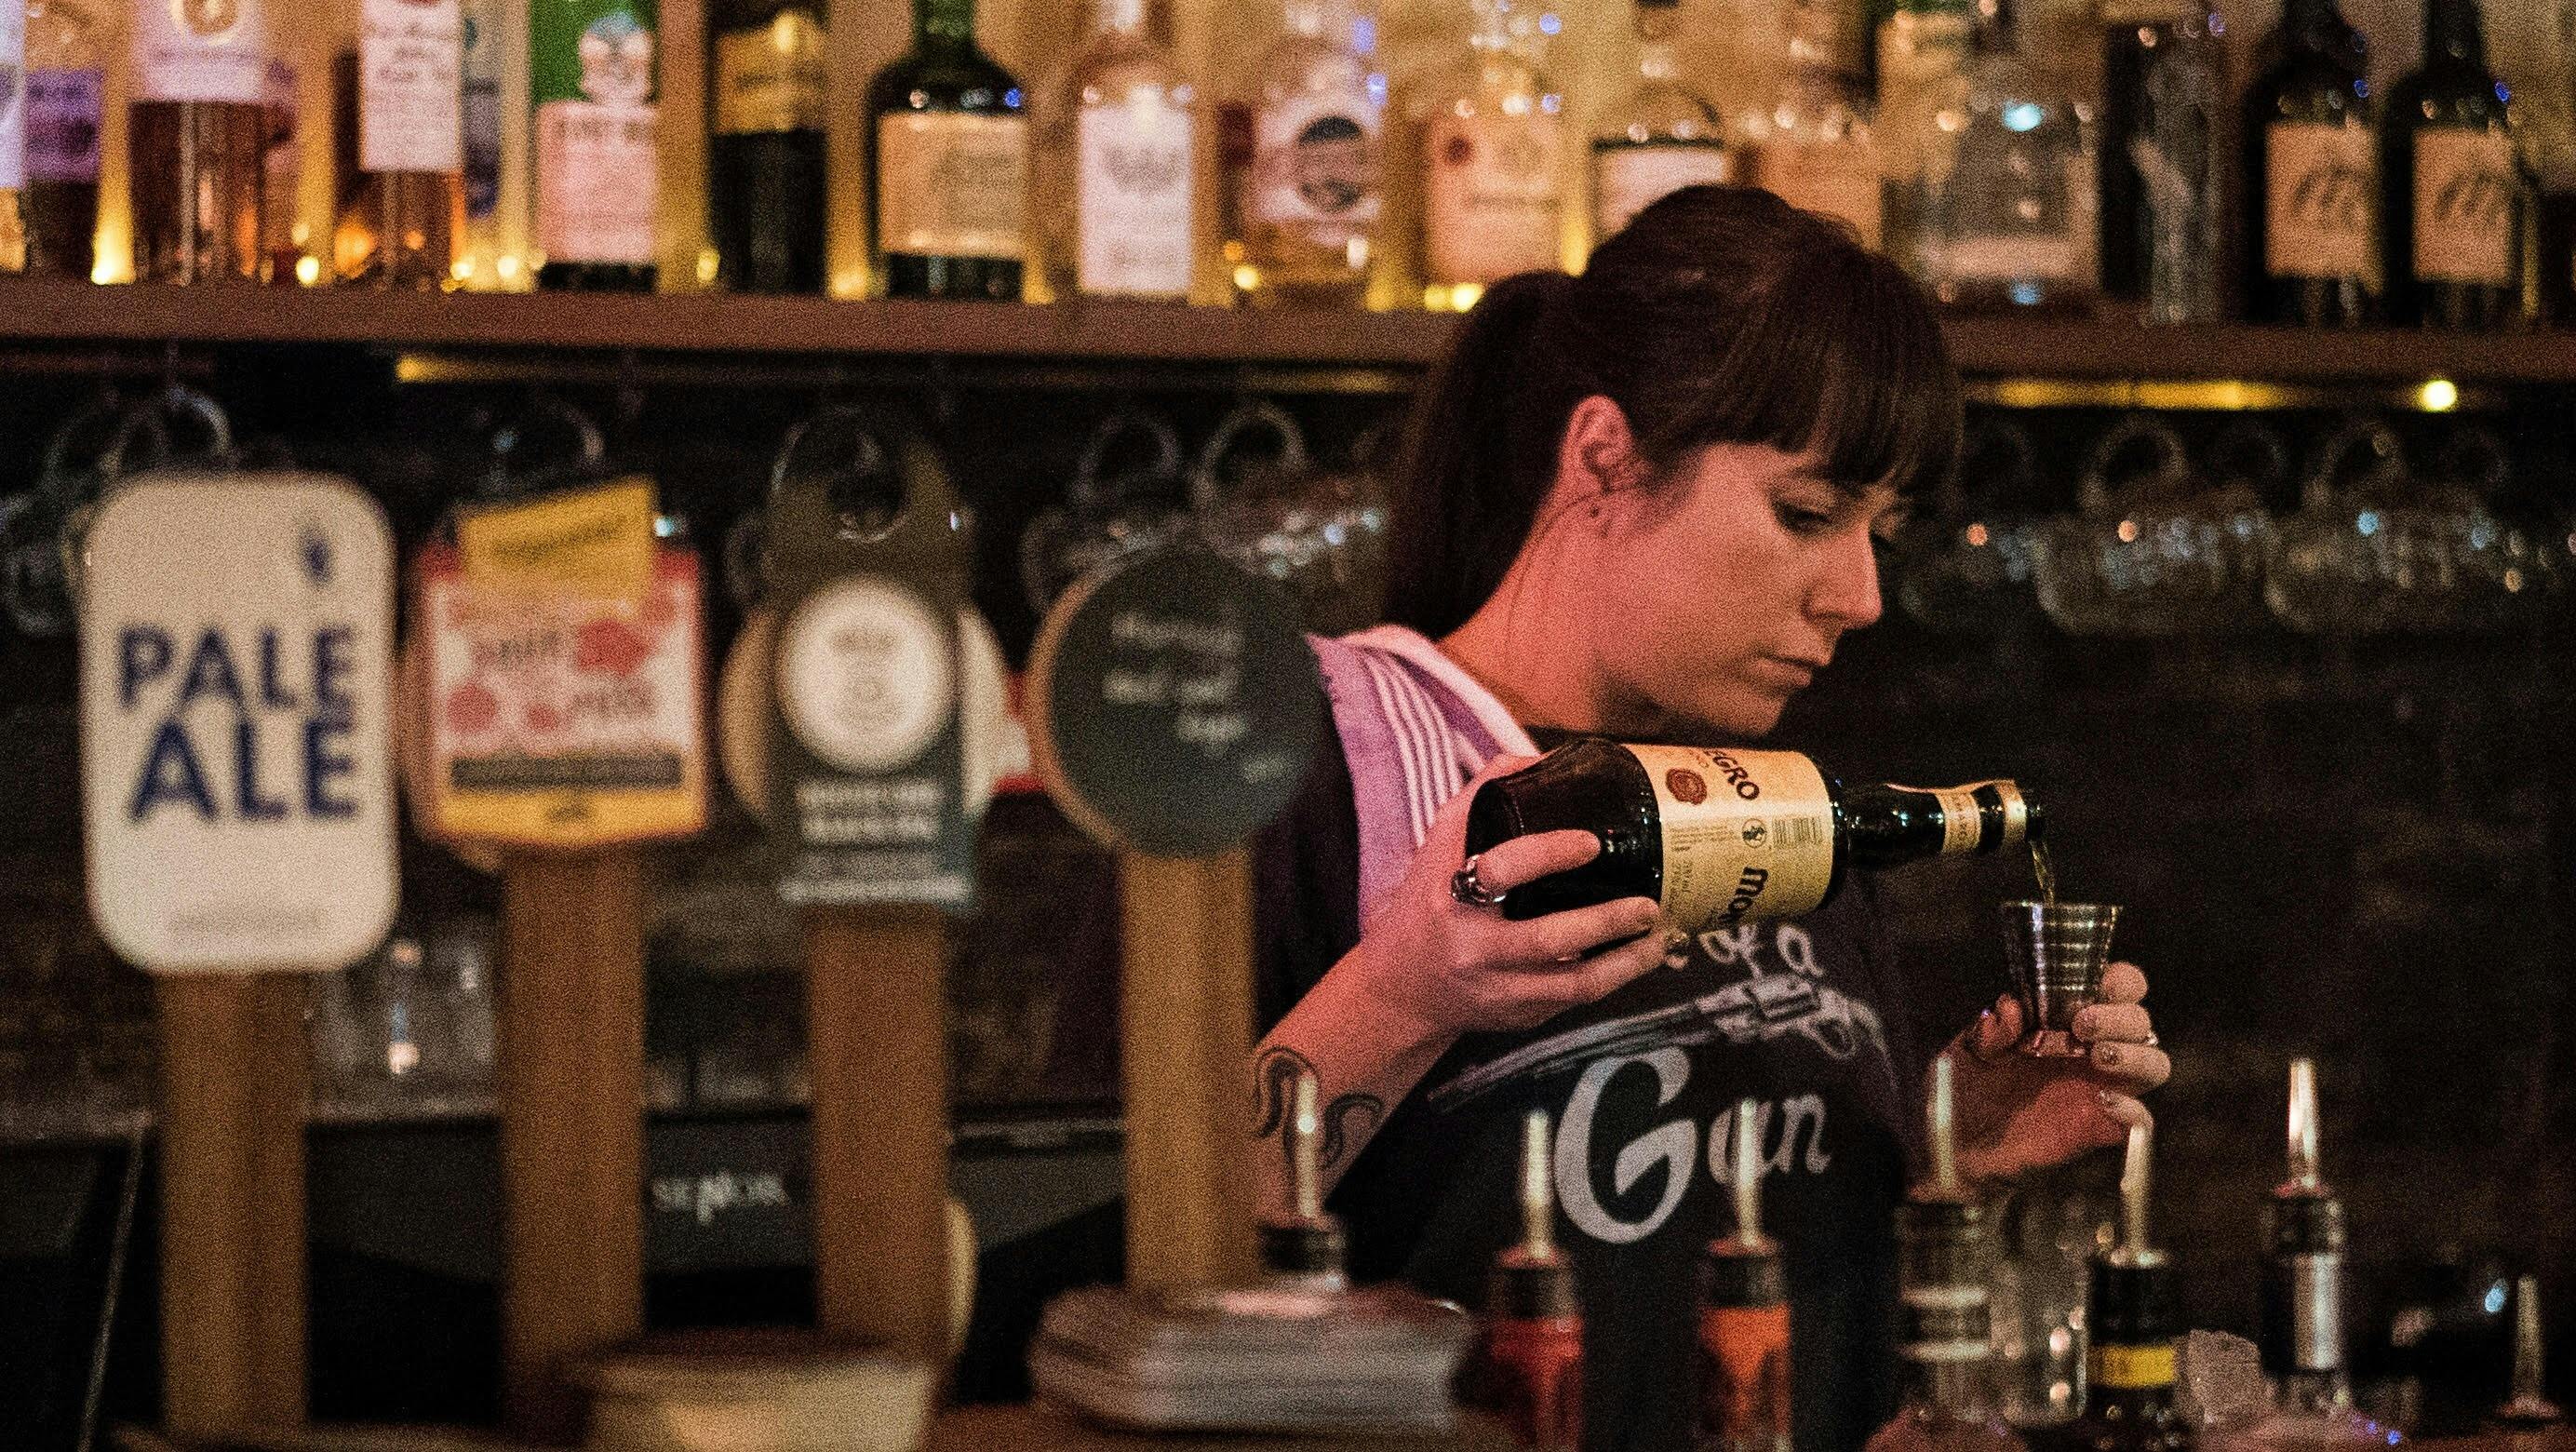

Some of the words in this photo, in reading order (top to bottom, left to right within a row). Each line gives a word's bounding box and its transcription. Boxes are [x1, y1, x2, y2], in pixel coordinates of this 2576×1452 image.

[116, 624, 357, 712] PALE
[128, 718, 359, 823] ALE
[1777, 923, 1825, 977] a
